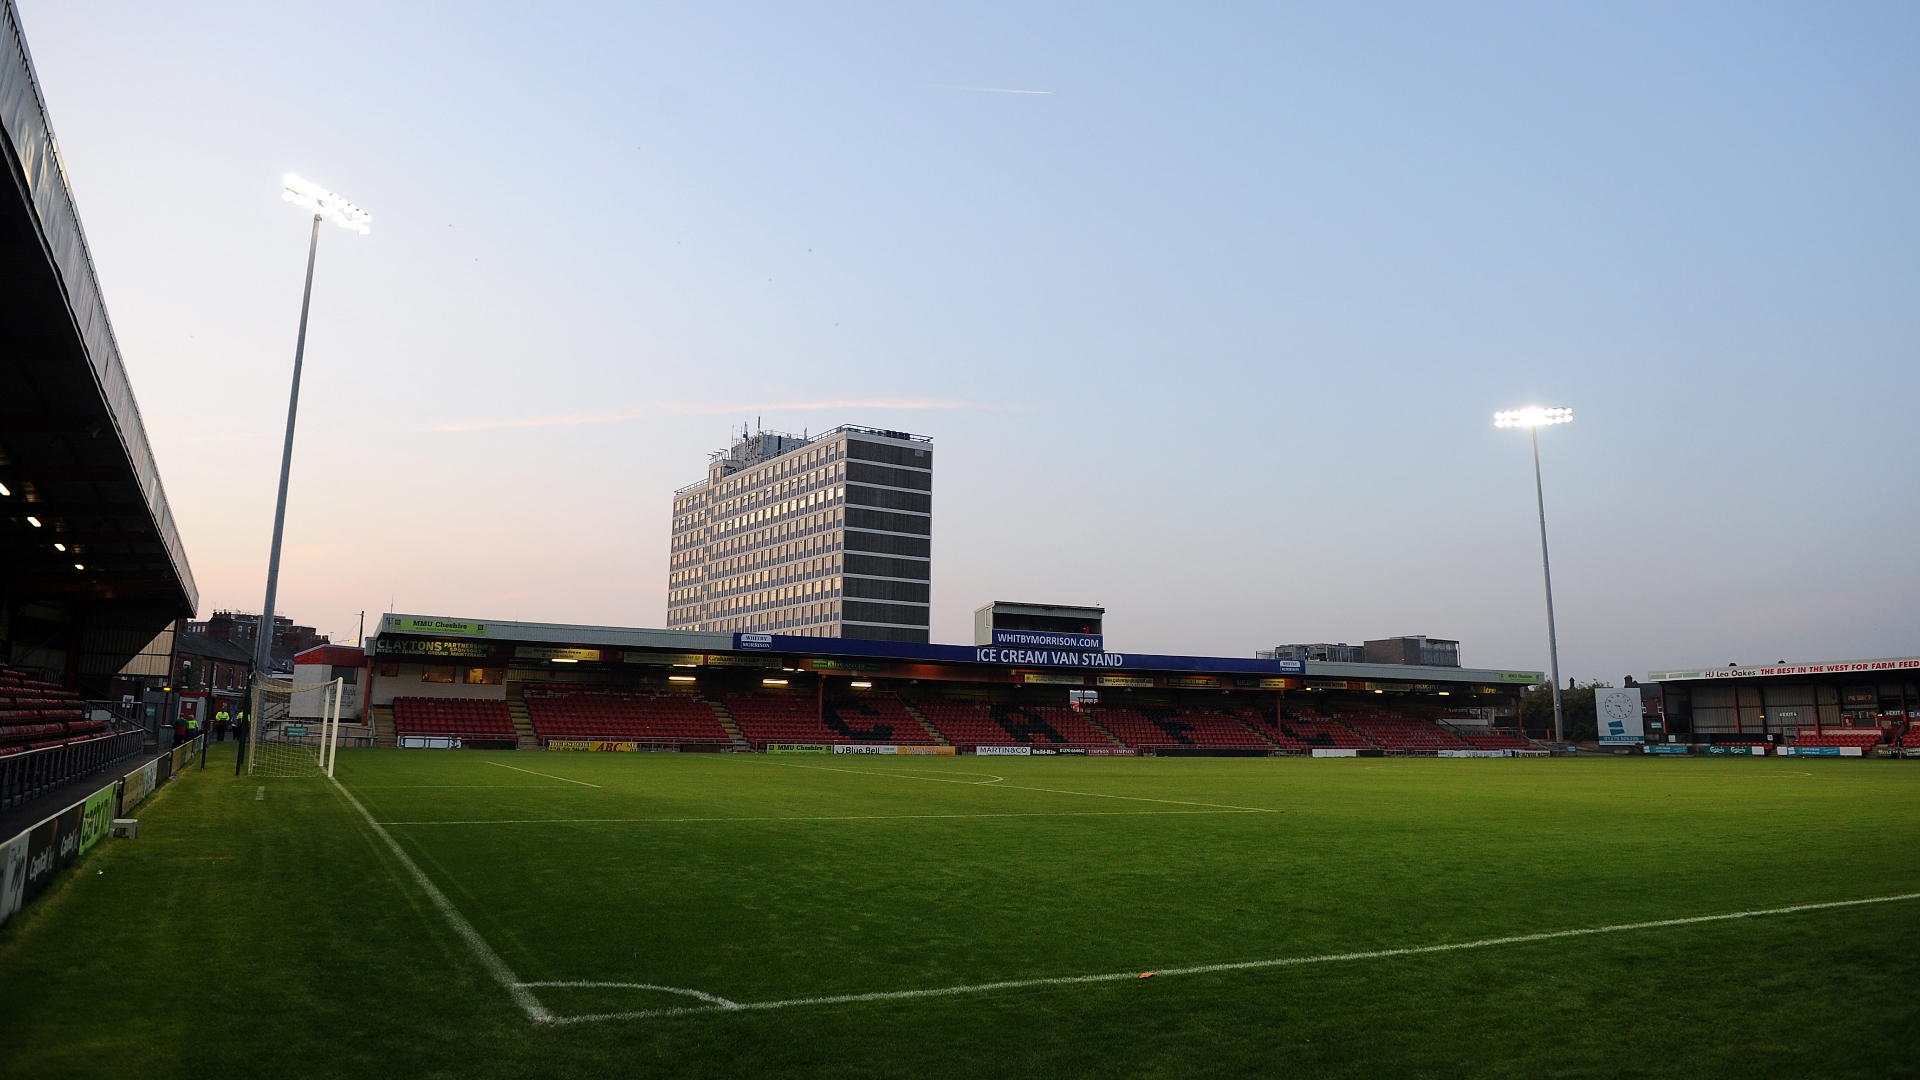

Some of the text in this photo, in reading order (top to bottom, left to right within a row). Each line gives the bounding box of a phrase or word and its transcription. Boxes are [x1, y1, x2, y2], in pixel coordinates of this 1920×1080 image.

[435, 621, 467, 630] Cheshire
[376, 639, 442, 652] CLAYTONS
[443, 642, 489, 650] PARTNERSHIP
[997, 633, 1100, 648] WHITBYMORRISON.COM
[976, 647, 1124, 667] ICE CREAM VAN STAND
[1731, 669, 1756, 677] Oakes
[1851, 663, 1869, 671] FOR
[1871, 662, 1896, 670] FARM
[1898, 660, 1920, 668] FEED
[845, 746, 863, 754] Blue
[865, 746, 880, 754] Bell
